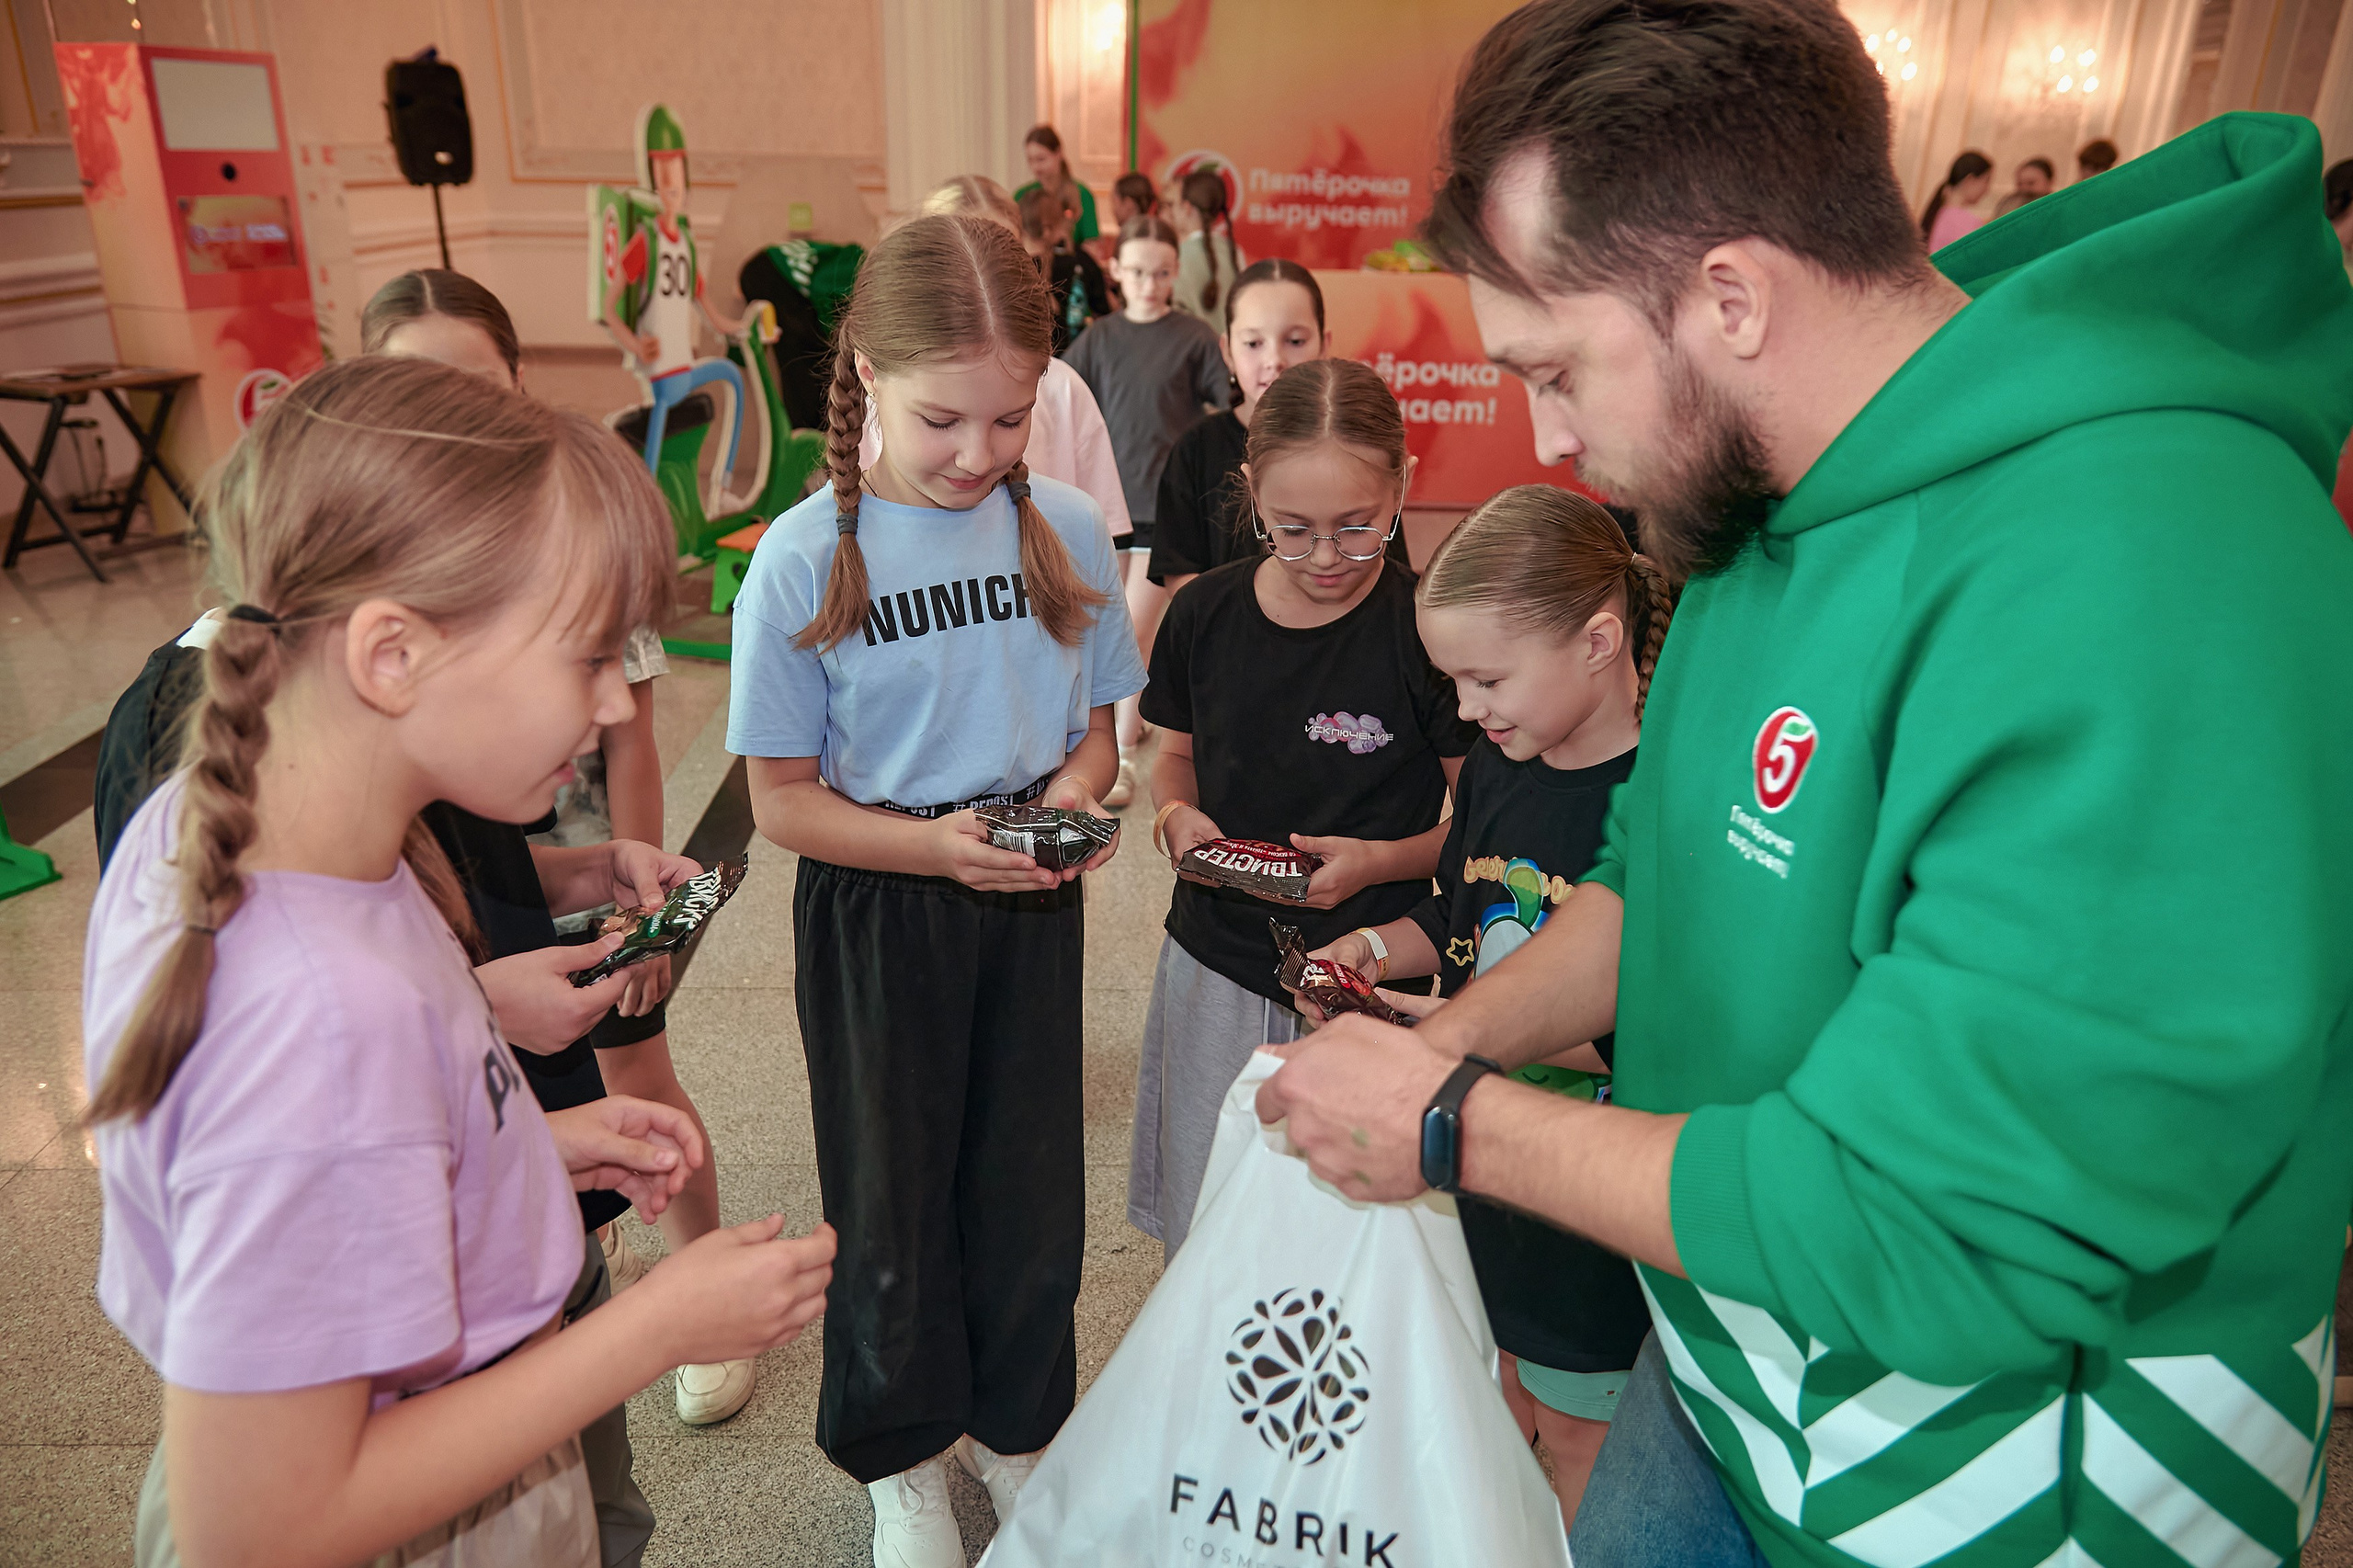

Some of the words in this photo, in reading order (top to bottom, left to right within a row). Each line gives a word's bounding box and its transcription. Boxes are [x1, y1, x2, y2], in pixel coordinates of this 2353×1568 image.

[1248, 201, 1408, 230] выручает!
[660, 252, 691, 297] 30
[1363, 352, 1501, 392] ёрочка
[1194, 847, 1303, 878] ТВИСТЕР
[1169, 1472, 1400, 1568] FABRIK
